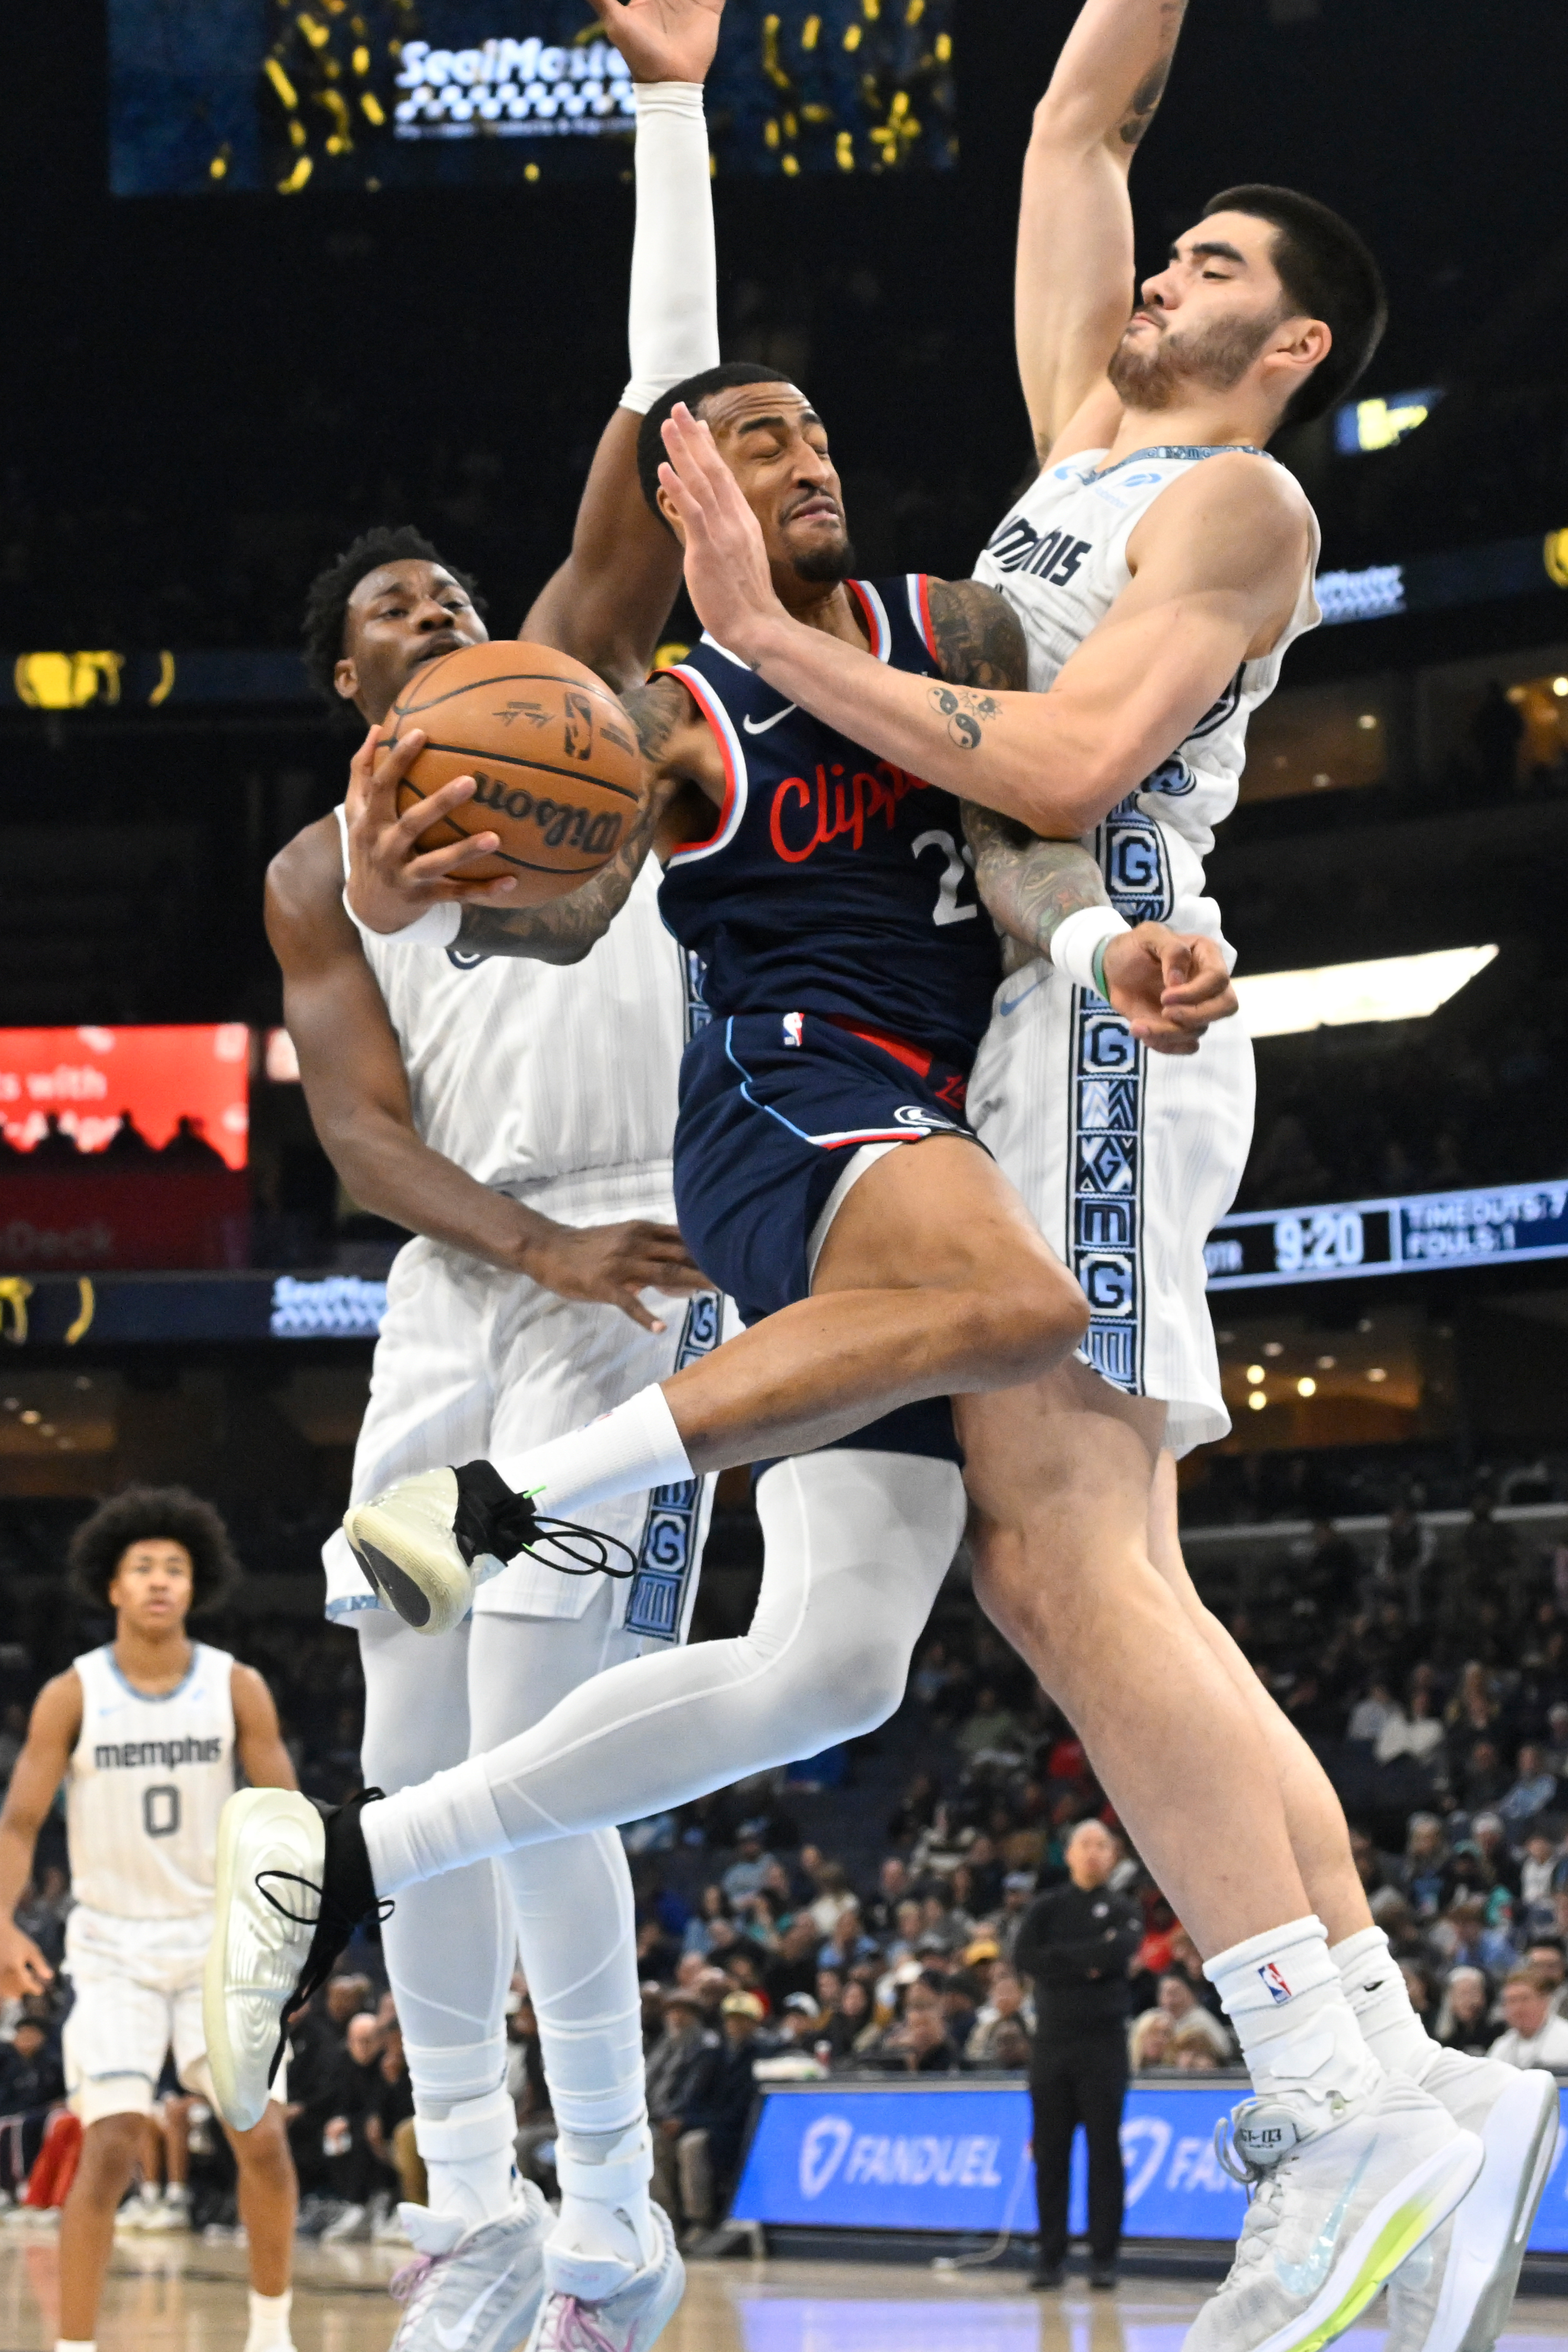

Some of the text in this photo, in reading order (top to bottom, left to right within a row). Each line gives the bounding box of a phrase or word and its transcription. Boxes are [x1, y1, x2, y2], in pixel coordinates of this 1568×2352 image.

[770, 761, 931, 863] Clipp
[911, 829, 978, 926] 2
[1273, 1210, 1365, 1273] 9:20
[142, 1785, 181, 1838] 0
[842, 2134, 1002, 2188] FANDUEL
